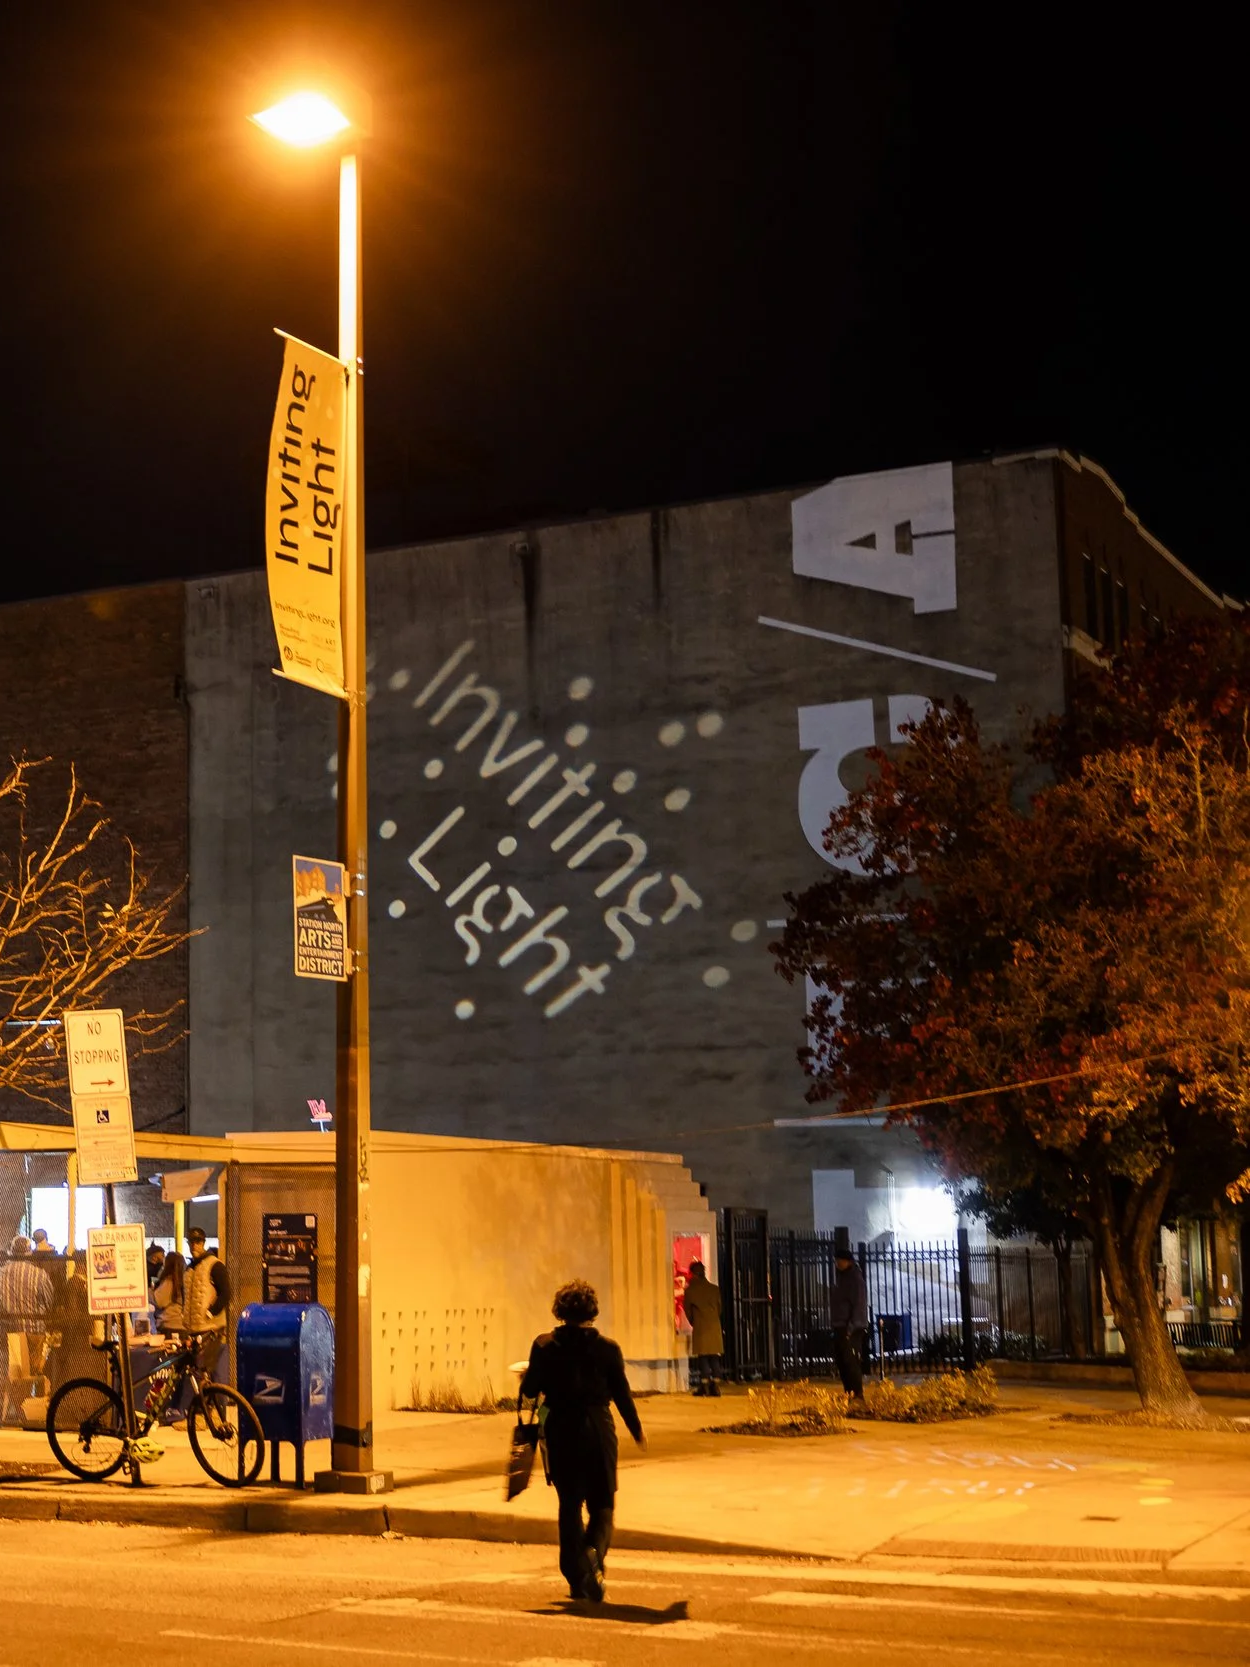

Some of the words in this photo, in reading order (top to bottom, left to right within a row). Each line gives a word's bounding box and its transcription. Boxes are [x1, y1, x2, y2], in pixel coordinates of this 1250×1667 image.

[275, 363, 316, 566] Inviting
[307, 437, 341, 576] Light
[413, 639, 702, 960] Inviting
[408, 806, 611, 1018] Light
[298, 917, 323, 930] STATION
[323, 920, 342, 933] NORTH
[299, 928, 332, 949] ARTS
[298, 945, 343, 960] ENTERTAINMENT
[298, 956, 343, 976] DISTRICT
[87, 1021, 102, 1036] NO
[74, 1049, 120, 1065] STOPPING
[92, 1232, 103, 1243] NO
[105, 1231, 138, 1243] PARKING
[109, 1298, 125, 1308] AWAY
